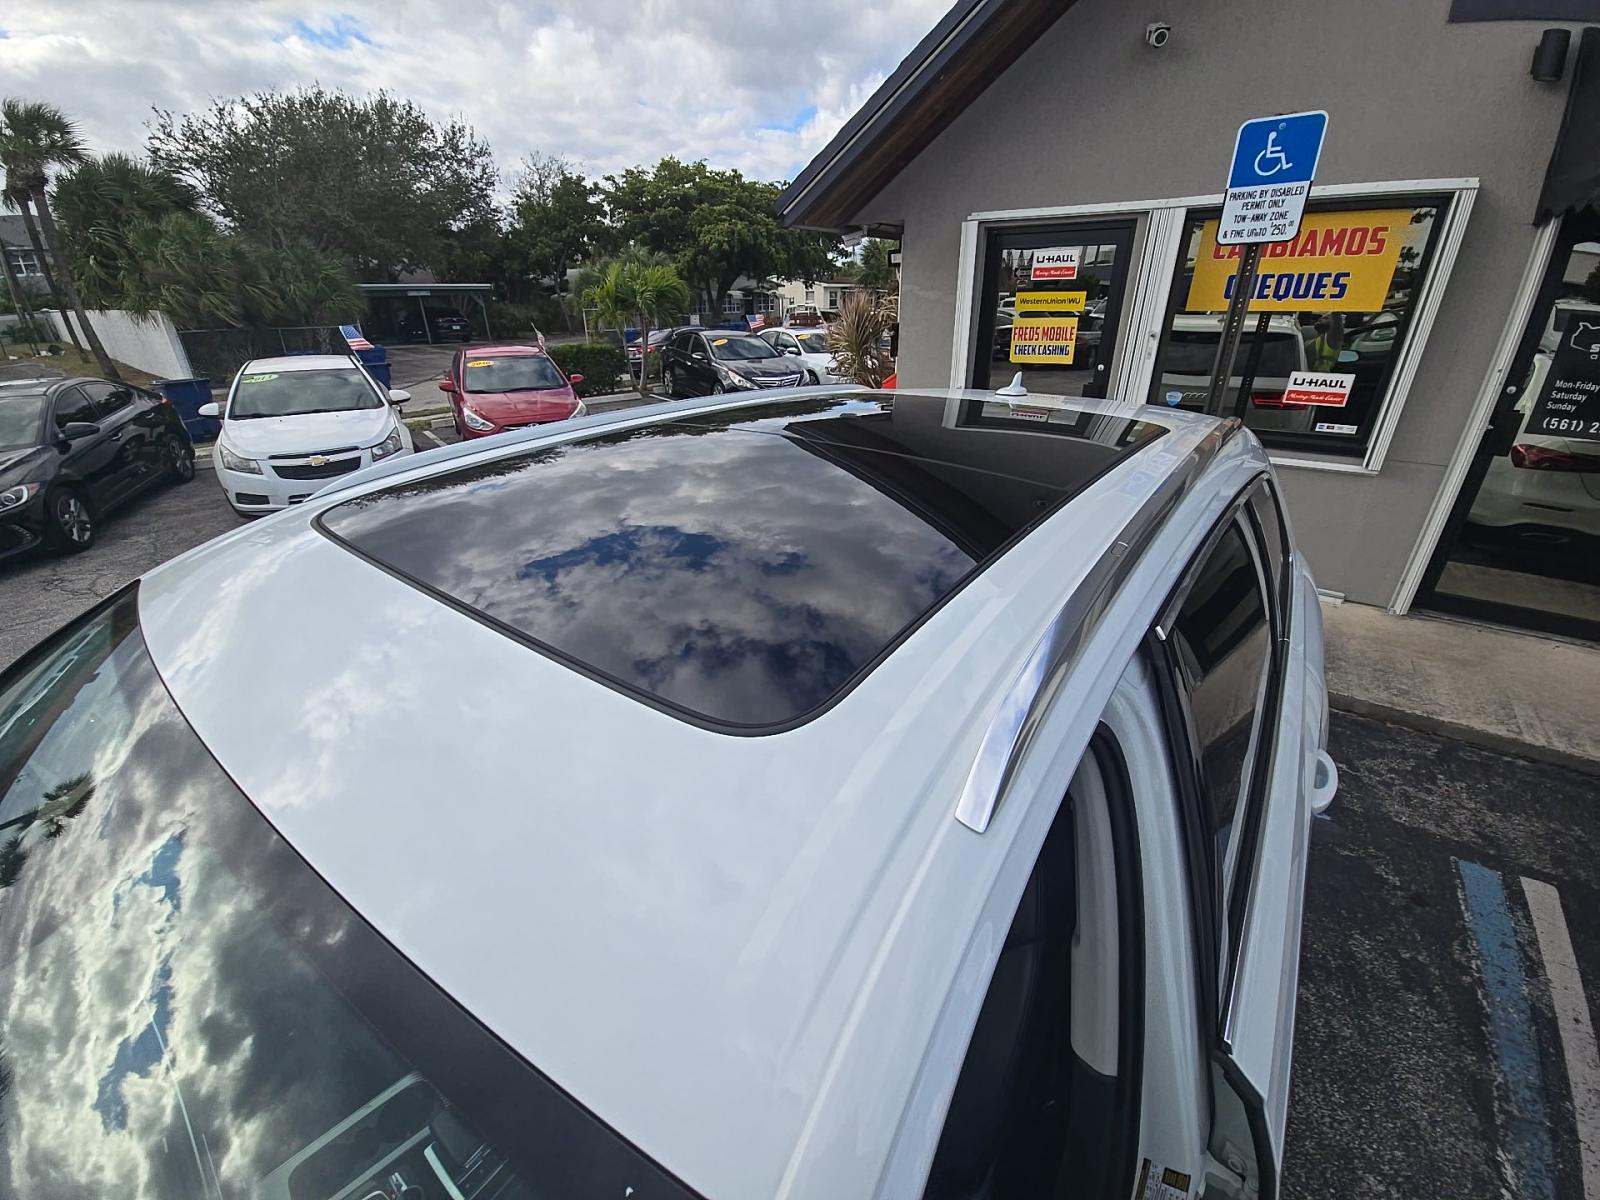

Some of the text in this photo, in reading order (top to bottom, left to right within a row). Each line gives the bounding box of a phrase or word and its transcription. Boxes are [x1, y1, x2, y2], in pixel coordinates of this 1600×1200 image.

[1229, 186, 1305, 201] PARKING BY DISABLED
[1242, 199, 1286, 211] PERMIT ONLY
[1234, 211, 1289, 224] TOW-AWAY ZONE
[1230, 228, 1244, 238] FINE
[1213, 226, 1389, 259] CABIAMOS
[1036, 254, 1076, 264] U-HAUL
[1223, 272, 1351, 301] CEQUES
[1013, 326, 1076, 341] FREDS MOBILE
[1014, 344, 1070, 356] CHECK CASHING
[1293, 378, 1347, 389] U-HAUL
[1554, 379, 1600, 393] Mon-Friday
[1550, 390, 1587, 403] Saturday
[1546, 401, 1577, 412] Sunday
[1543, 417, 1584, 432] (561)
